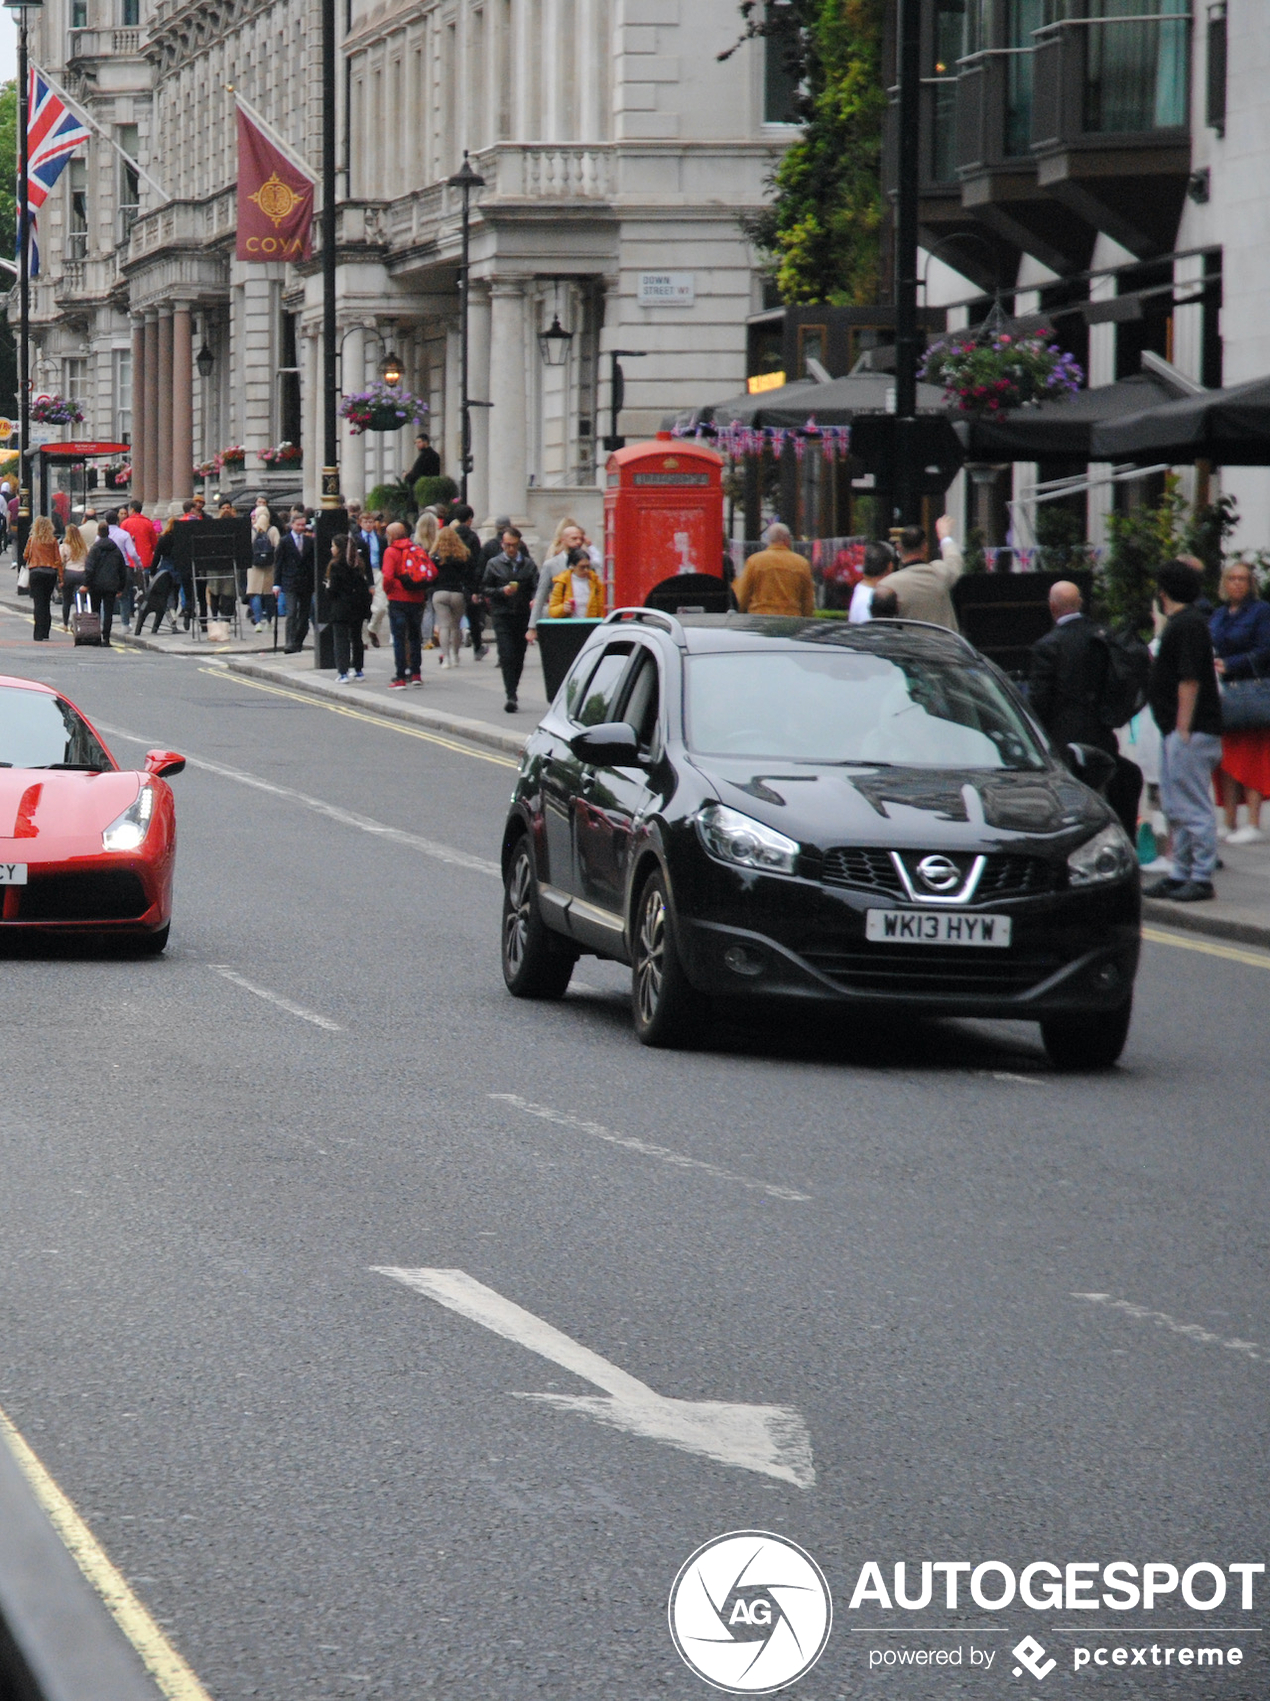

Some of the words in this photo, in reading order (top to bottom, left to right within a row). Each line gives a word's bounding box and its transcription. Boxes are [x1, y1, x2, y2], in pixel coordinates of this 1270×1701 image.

[246, 237, 303, 252] COYA
[642, 276, 670, 285] DOWN
[642, 286, 674, 295] STREET
[884, 914, 939, 938] WK13
[947, 916, 995, 941] HYW
